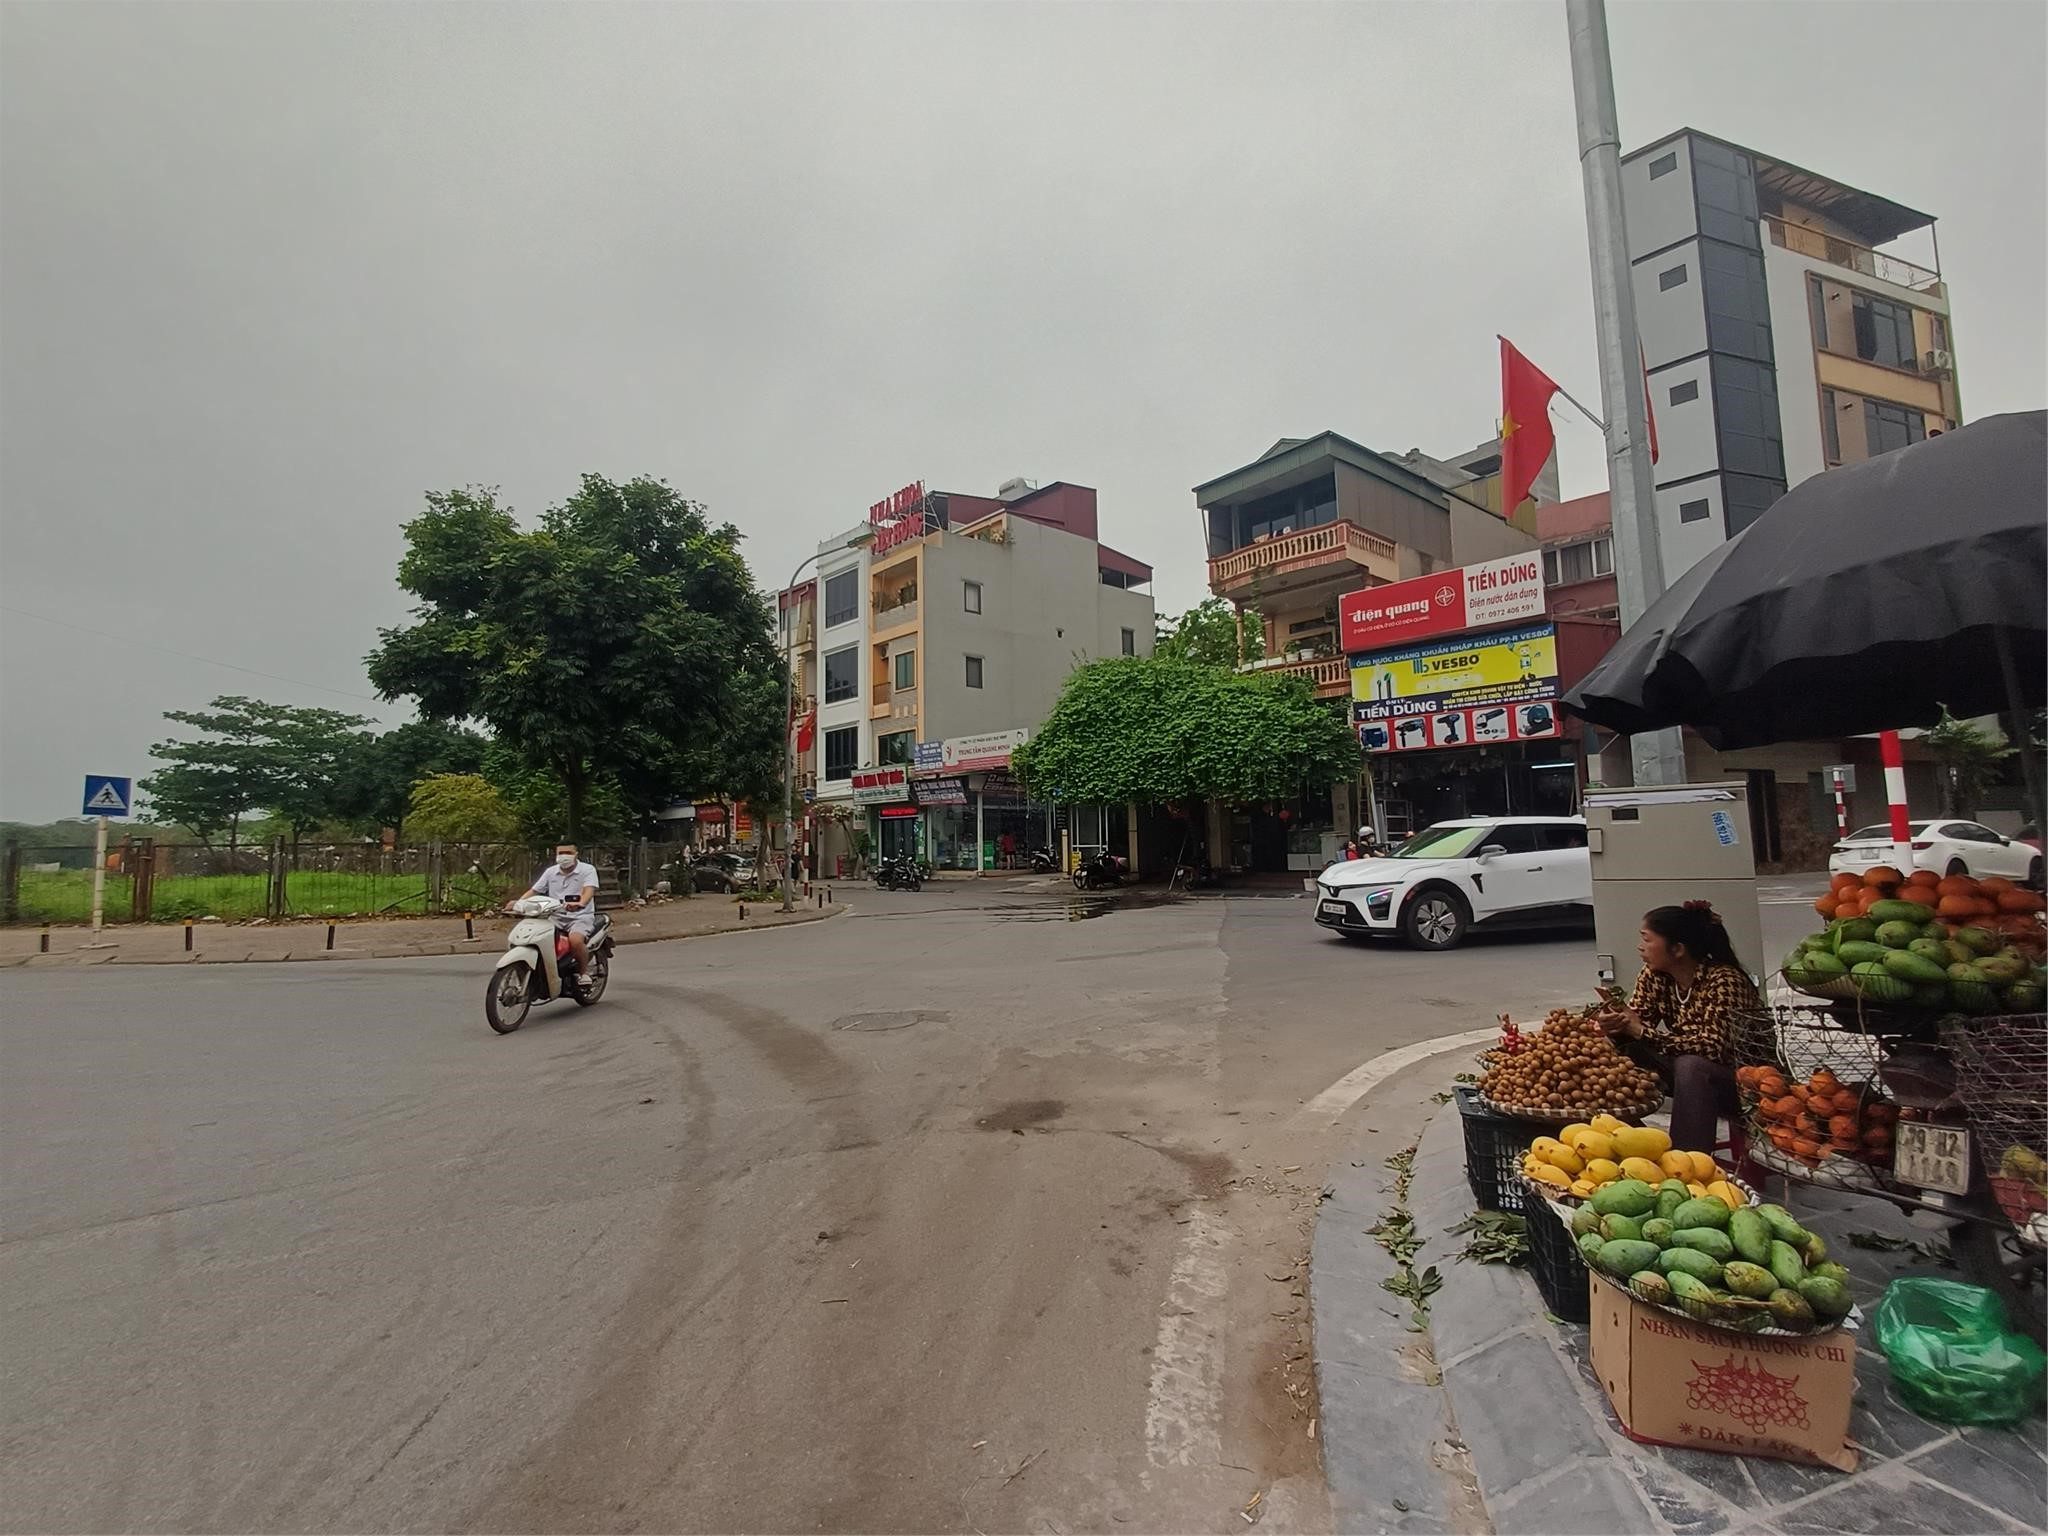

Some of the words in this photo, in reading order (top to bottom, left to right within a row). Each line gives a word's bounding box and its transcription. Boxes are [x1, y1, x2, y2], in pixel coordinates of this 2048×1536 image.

[1468, 566, 1497, 592] TIẾN
[1501, 562, 1537, 586] DŨNG
[1348, 609, 1382, 622] điện
[1385, 600, 1429, 620] quang
[1488, 609, 1505, 618] 0972
[1394, 651, 1420, 662] KHÁNG
[1432, 654, 1480, 671] VESBO
[1358, 702, 1390, 719] TIẾN
[1393, 700, 1437, 715] DŨNG
[1814, 1345, 1847, 1363] CHI
